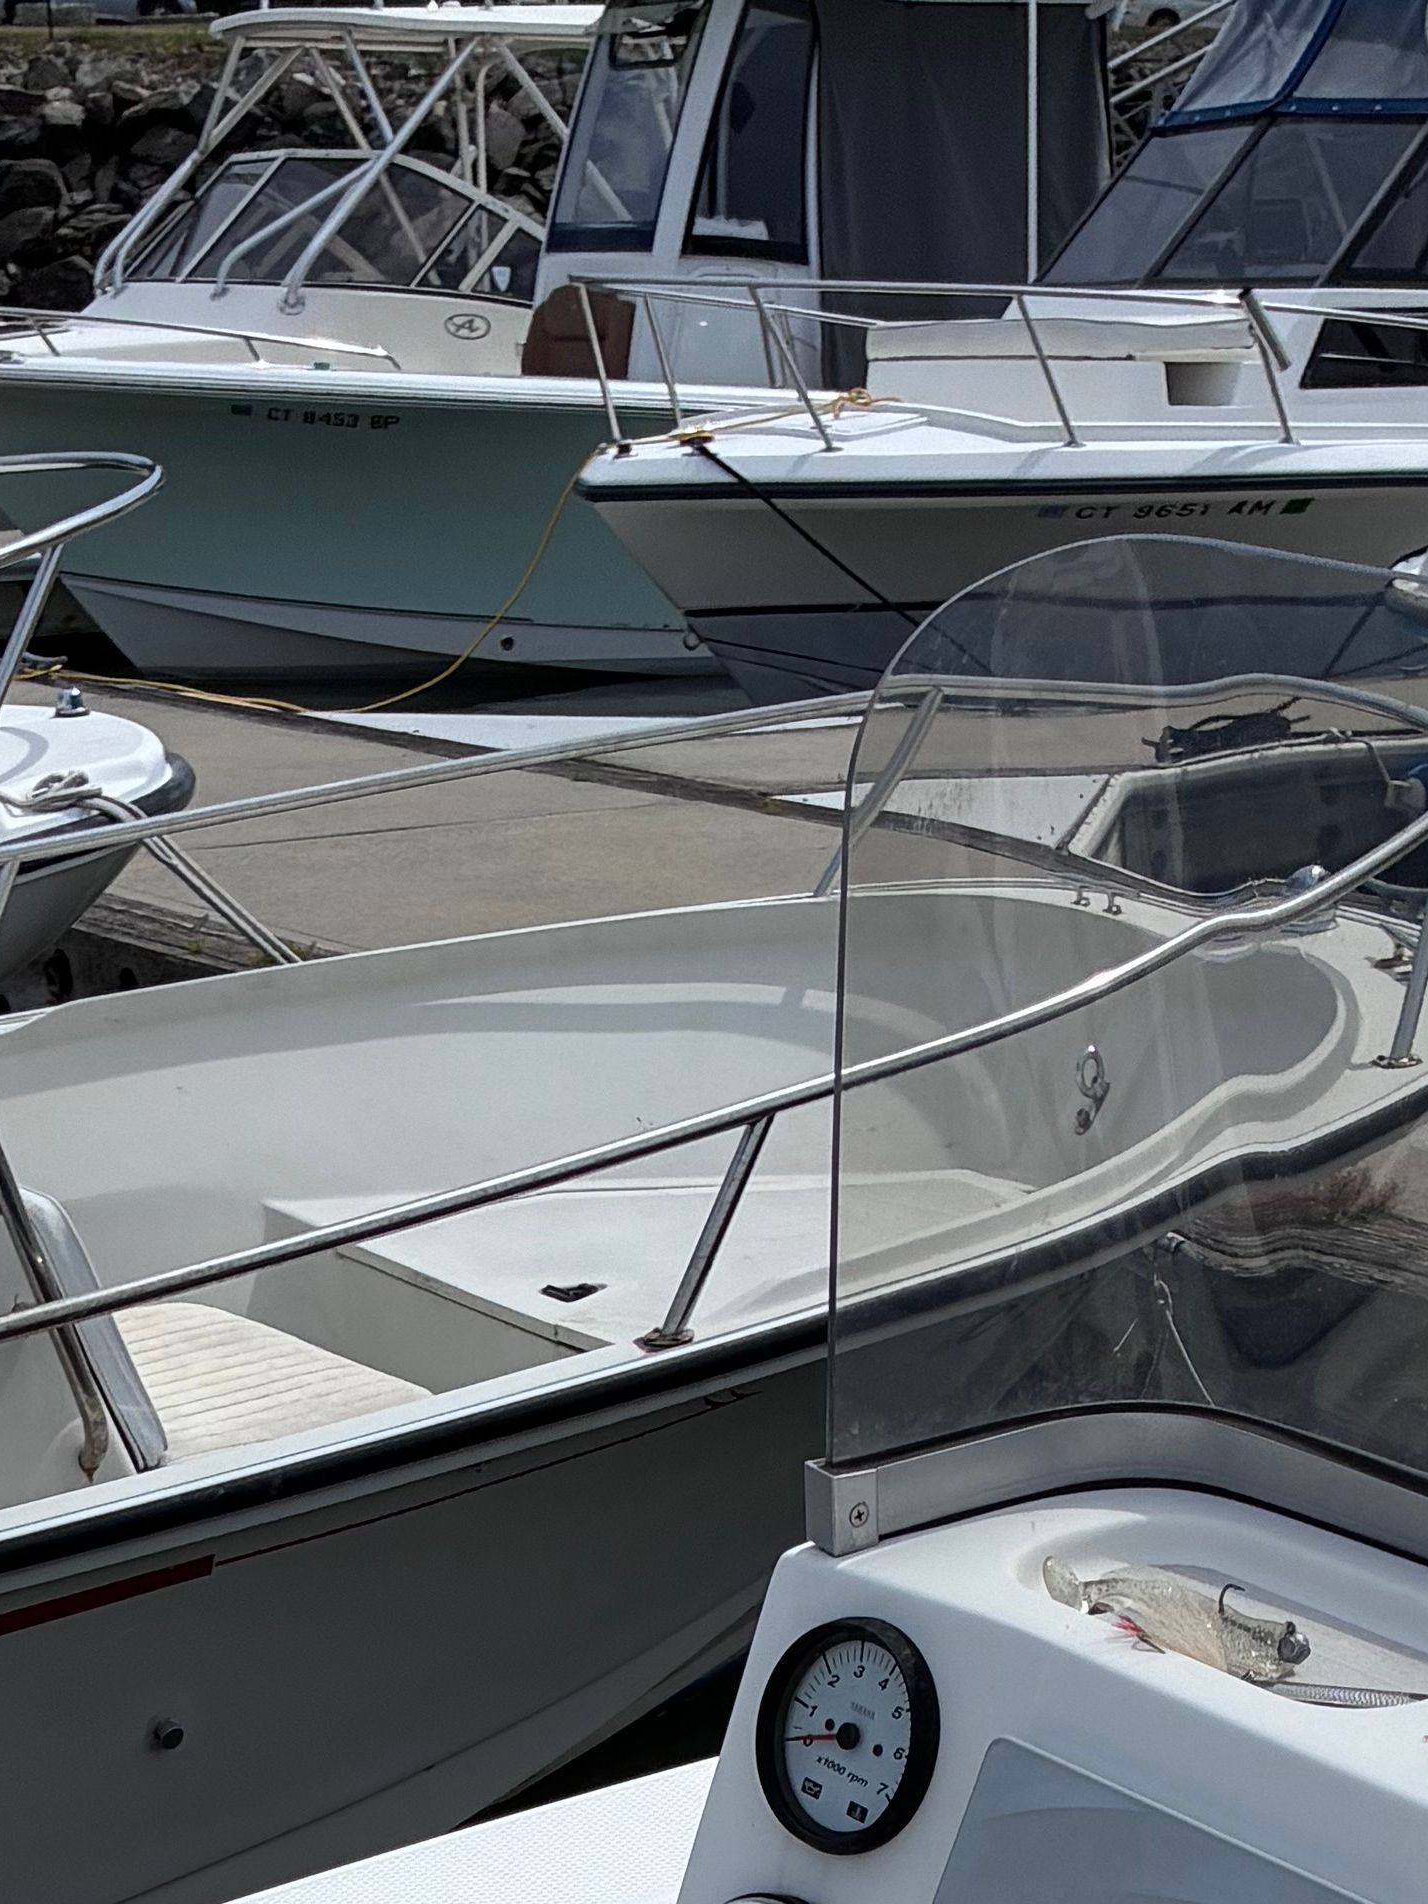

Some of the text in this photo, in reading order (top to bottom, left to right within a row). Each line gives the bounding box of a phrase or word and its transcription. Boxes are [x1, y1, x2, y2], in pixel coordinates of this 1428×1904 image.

[268, 407, 292, 421] CT
[1075, 500, 1277, 520] CT 9651 AM
[853, 1665, 866, 1679] 3
[827, 1674, 841, 1688] 2
[878, 1678, 891, 1692] 4
[808, 1704, 819, 1718] 1
[891, 1705, 904, 1720] 5
[893, 1747, 906, 1761] 6
[846, 1769, 869, 1788] rpm
[875, 1781, 889, 1795] 7
